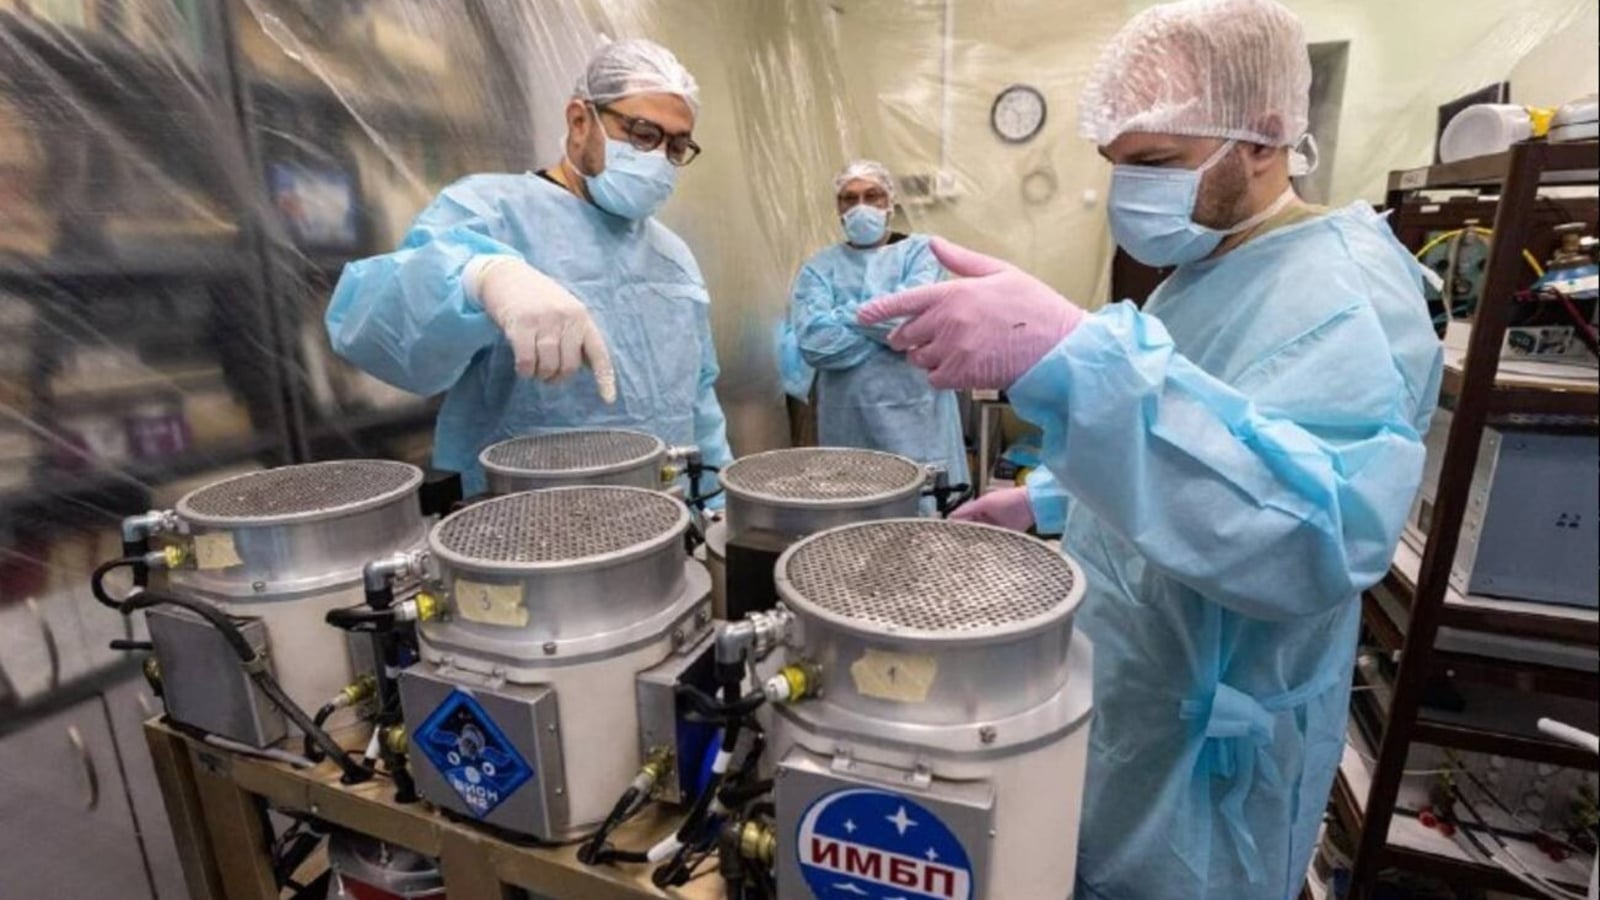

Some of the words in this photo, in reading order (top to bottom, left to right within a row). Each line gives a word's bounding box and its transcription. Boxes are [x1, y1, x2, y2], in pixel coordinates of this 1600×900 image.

[480, 589, 492, 612] 3
[886, 665, 896, 685] 1
[811, 837, 955, 898] ИМБП
